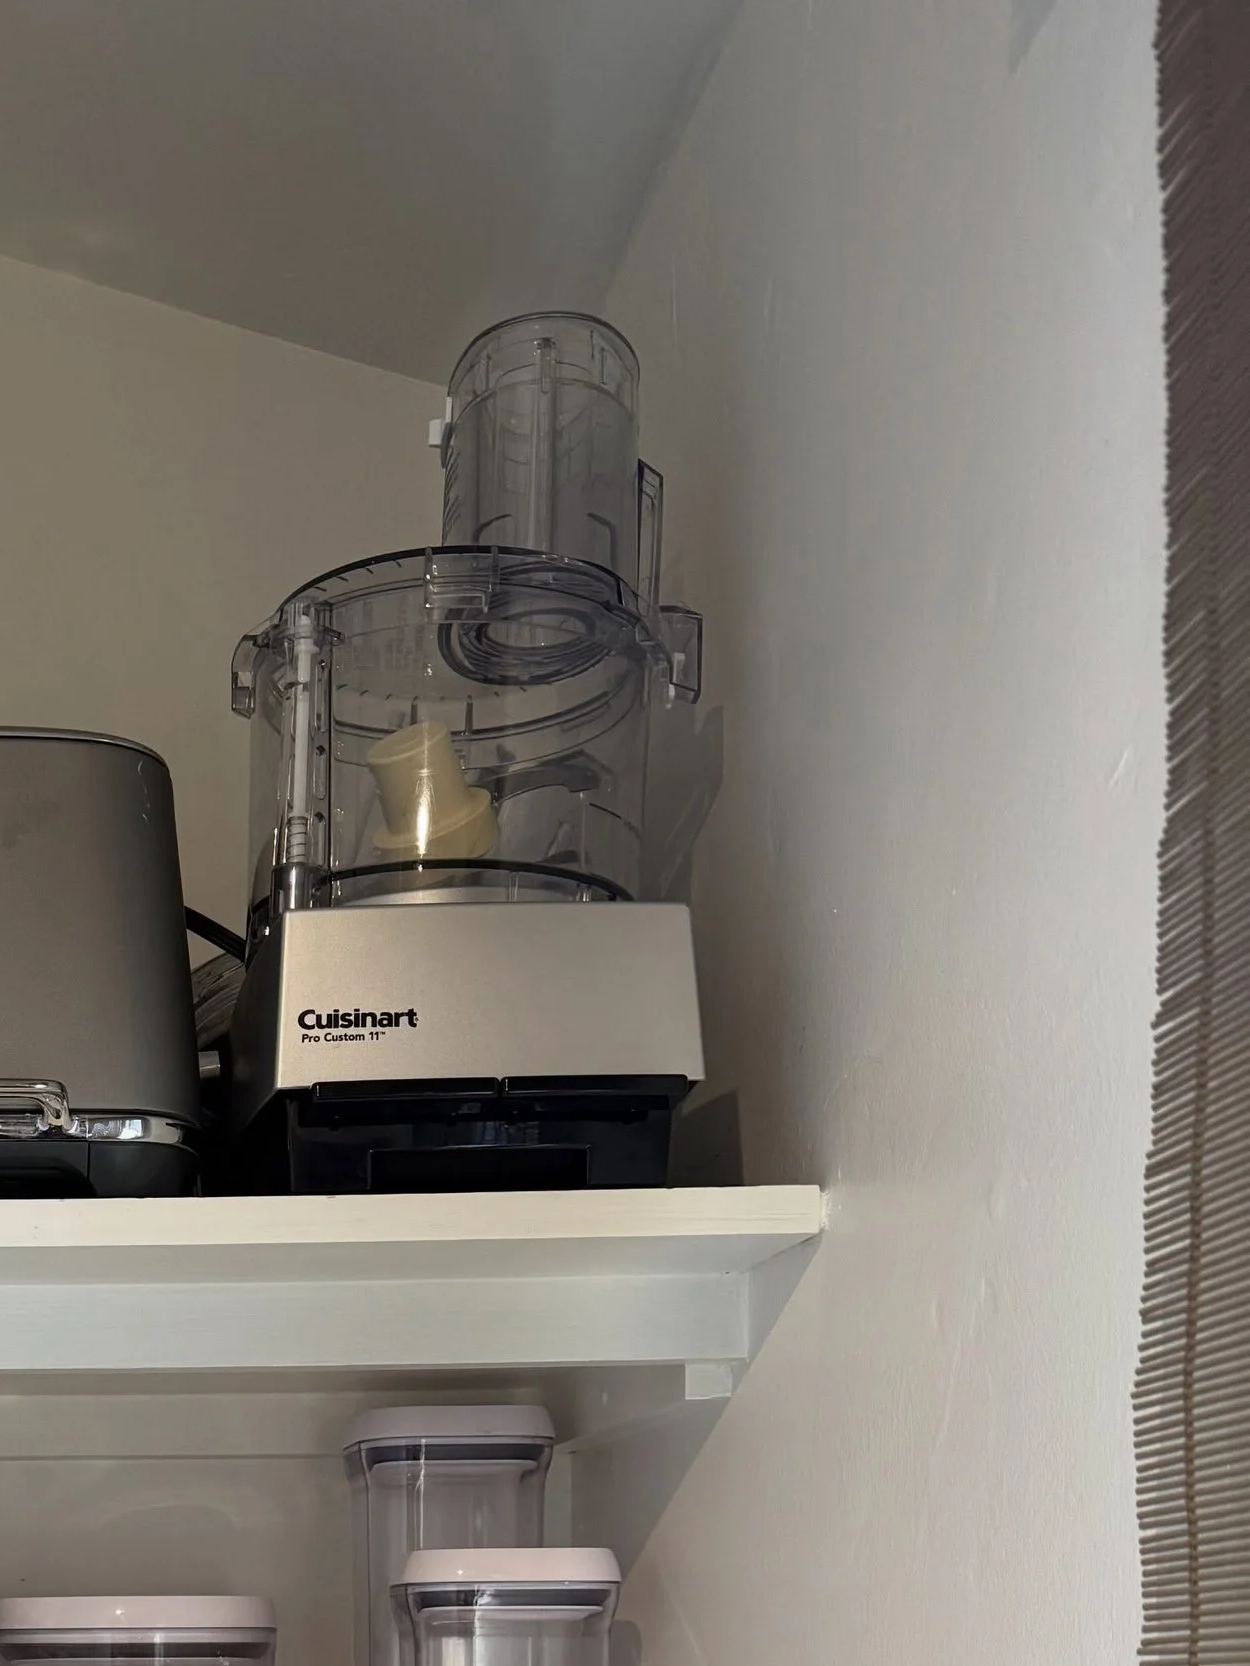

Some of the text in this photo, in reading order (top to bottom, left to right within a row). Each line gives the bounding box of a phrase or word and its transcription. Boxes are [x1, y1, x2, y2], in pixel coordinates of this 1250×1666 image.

[297, 1008, 417, 1030] Cuisinart
[301, 1034, 320, 1043] Pro
[324, 1033, 365, 1042] Custom
